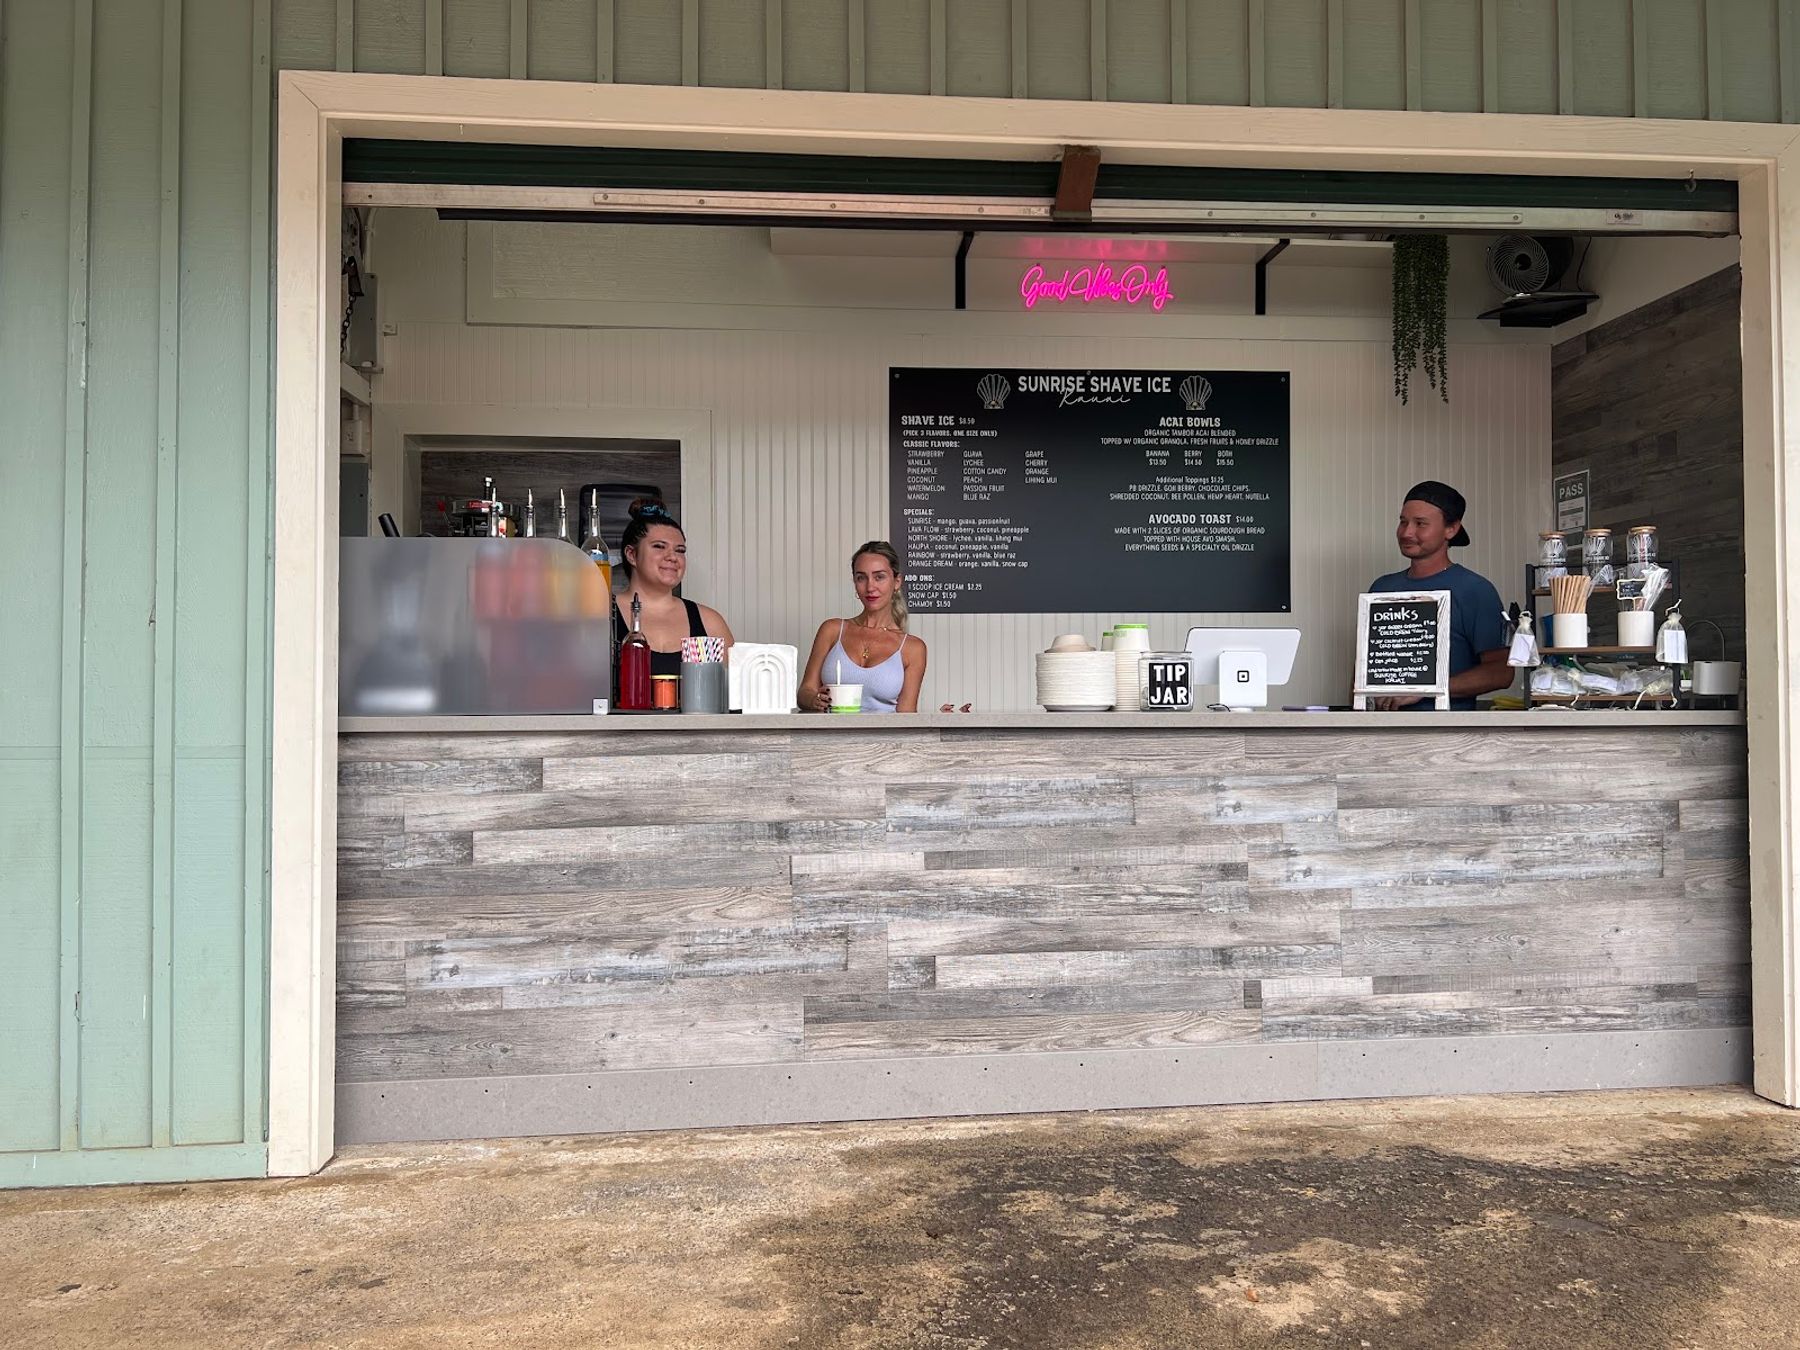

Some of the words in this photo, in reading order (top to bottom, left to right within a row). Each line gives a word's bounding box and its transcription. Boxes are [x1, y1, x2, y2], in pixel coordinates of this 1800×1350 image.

[1021, 266, 1069, 308] Good
[1069, 262, 1122, 301] Vibes
[1121, 264, 1174, 310] Only
[1018, 376, 1085, 392] SUNRISE
[1090, 377, 1141, 392] SHAVE
[1148, 377, 1171, 392] ICE
[1059, 388, 1130, 408] Kauai
[901, 415, 934, 426] SHAVE
[939, 415, 955, 426] ICE
[1159, 417, 1183, 427] ACAI
[1187, 417, 1220, 427] BOWLS
[1559, 482, 1583, 499] PASS
[1149, 514, 1196, 524] AVOCADO
[1200, 514, 1231, 524] TOAST
[1153, 664, 1186, 682] TIP
[1150, 687, 1188, 704] JAR
